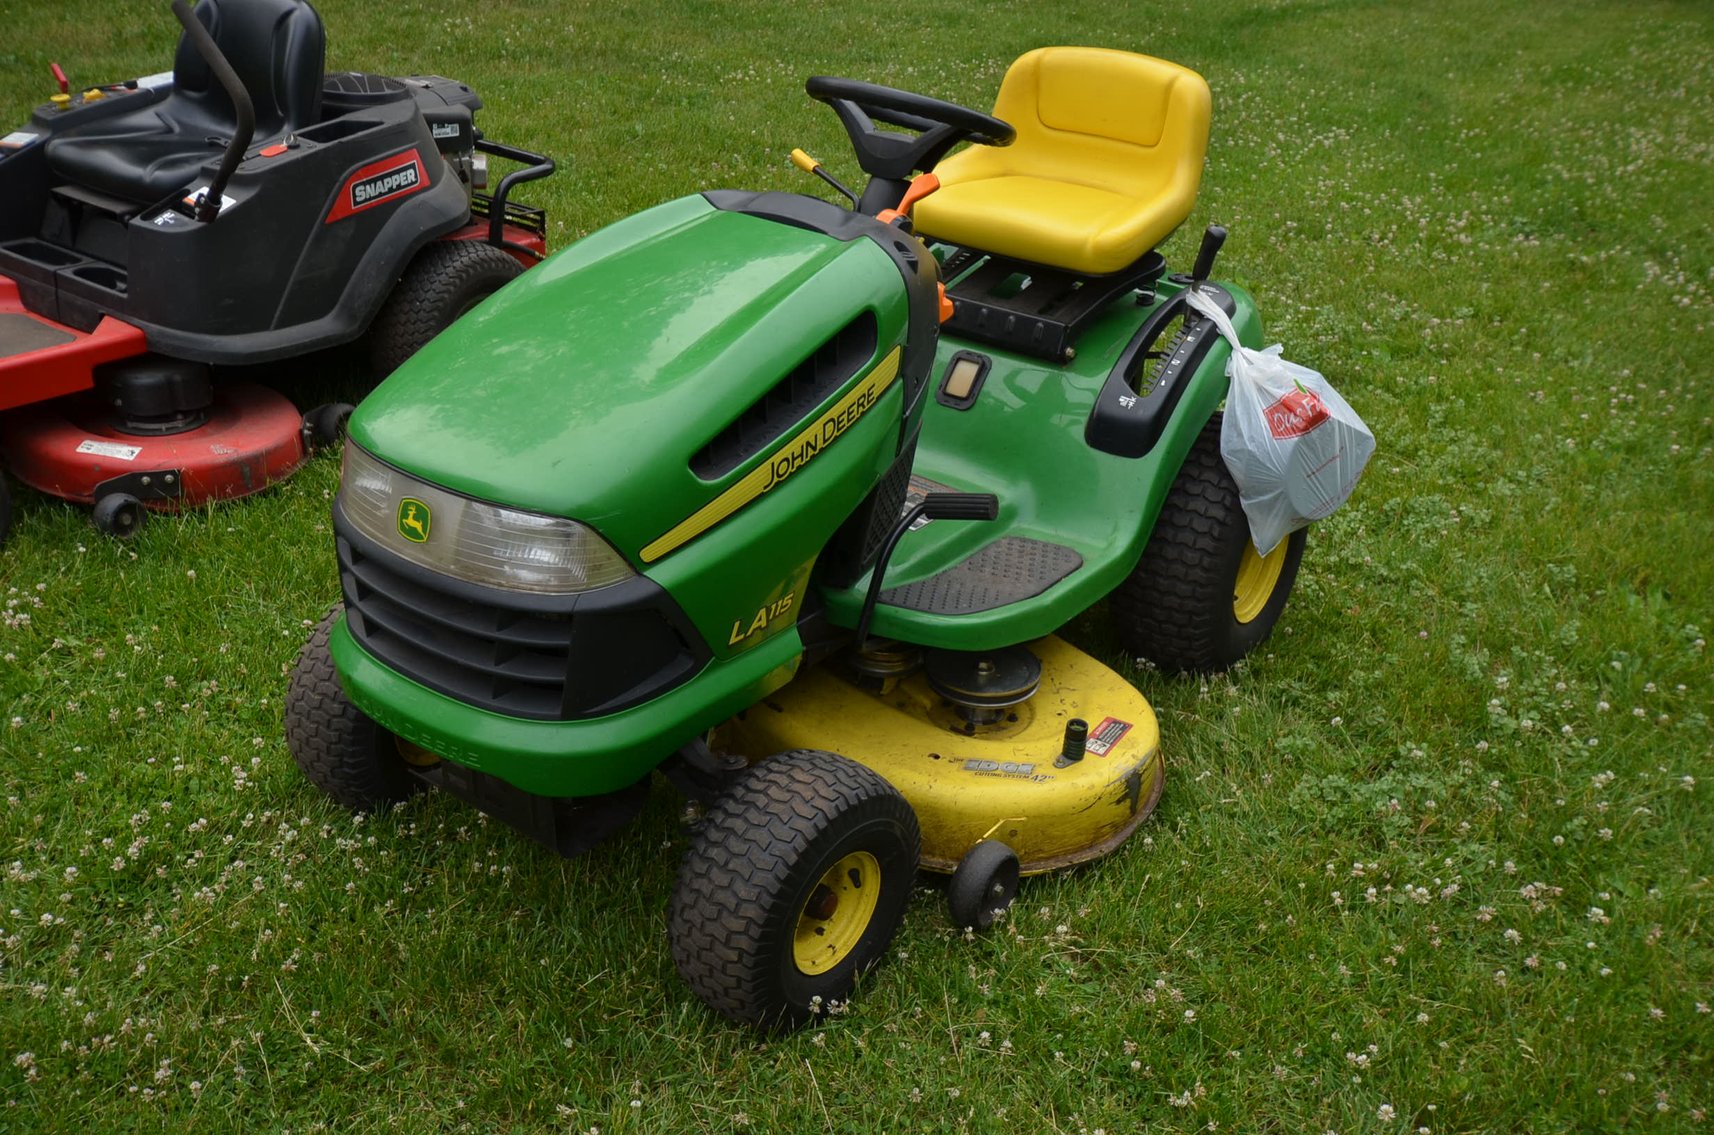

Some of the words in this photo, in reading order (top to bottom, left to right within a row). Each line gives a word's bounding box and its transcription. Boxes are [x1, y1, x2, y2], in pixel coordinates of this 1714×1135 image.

[355, 168, 416, 202] SNAPPER
[763, 434, 818, 490] JOHN
[822, 383, 876, 445] DEERE
[963, 759, 1035, 775] EDGE
